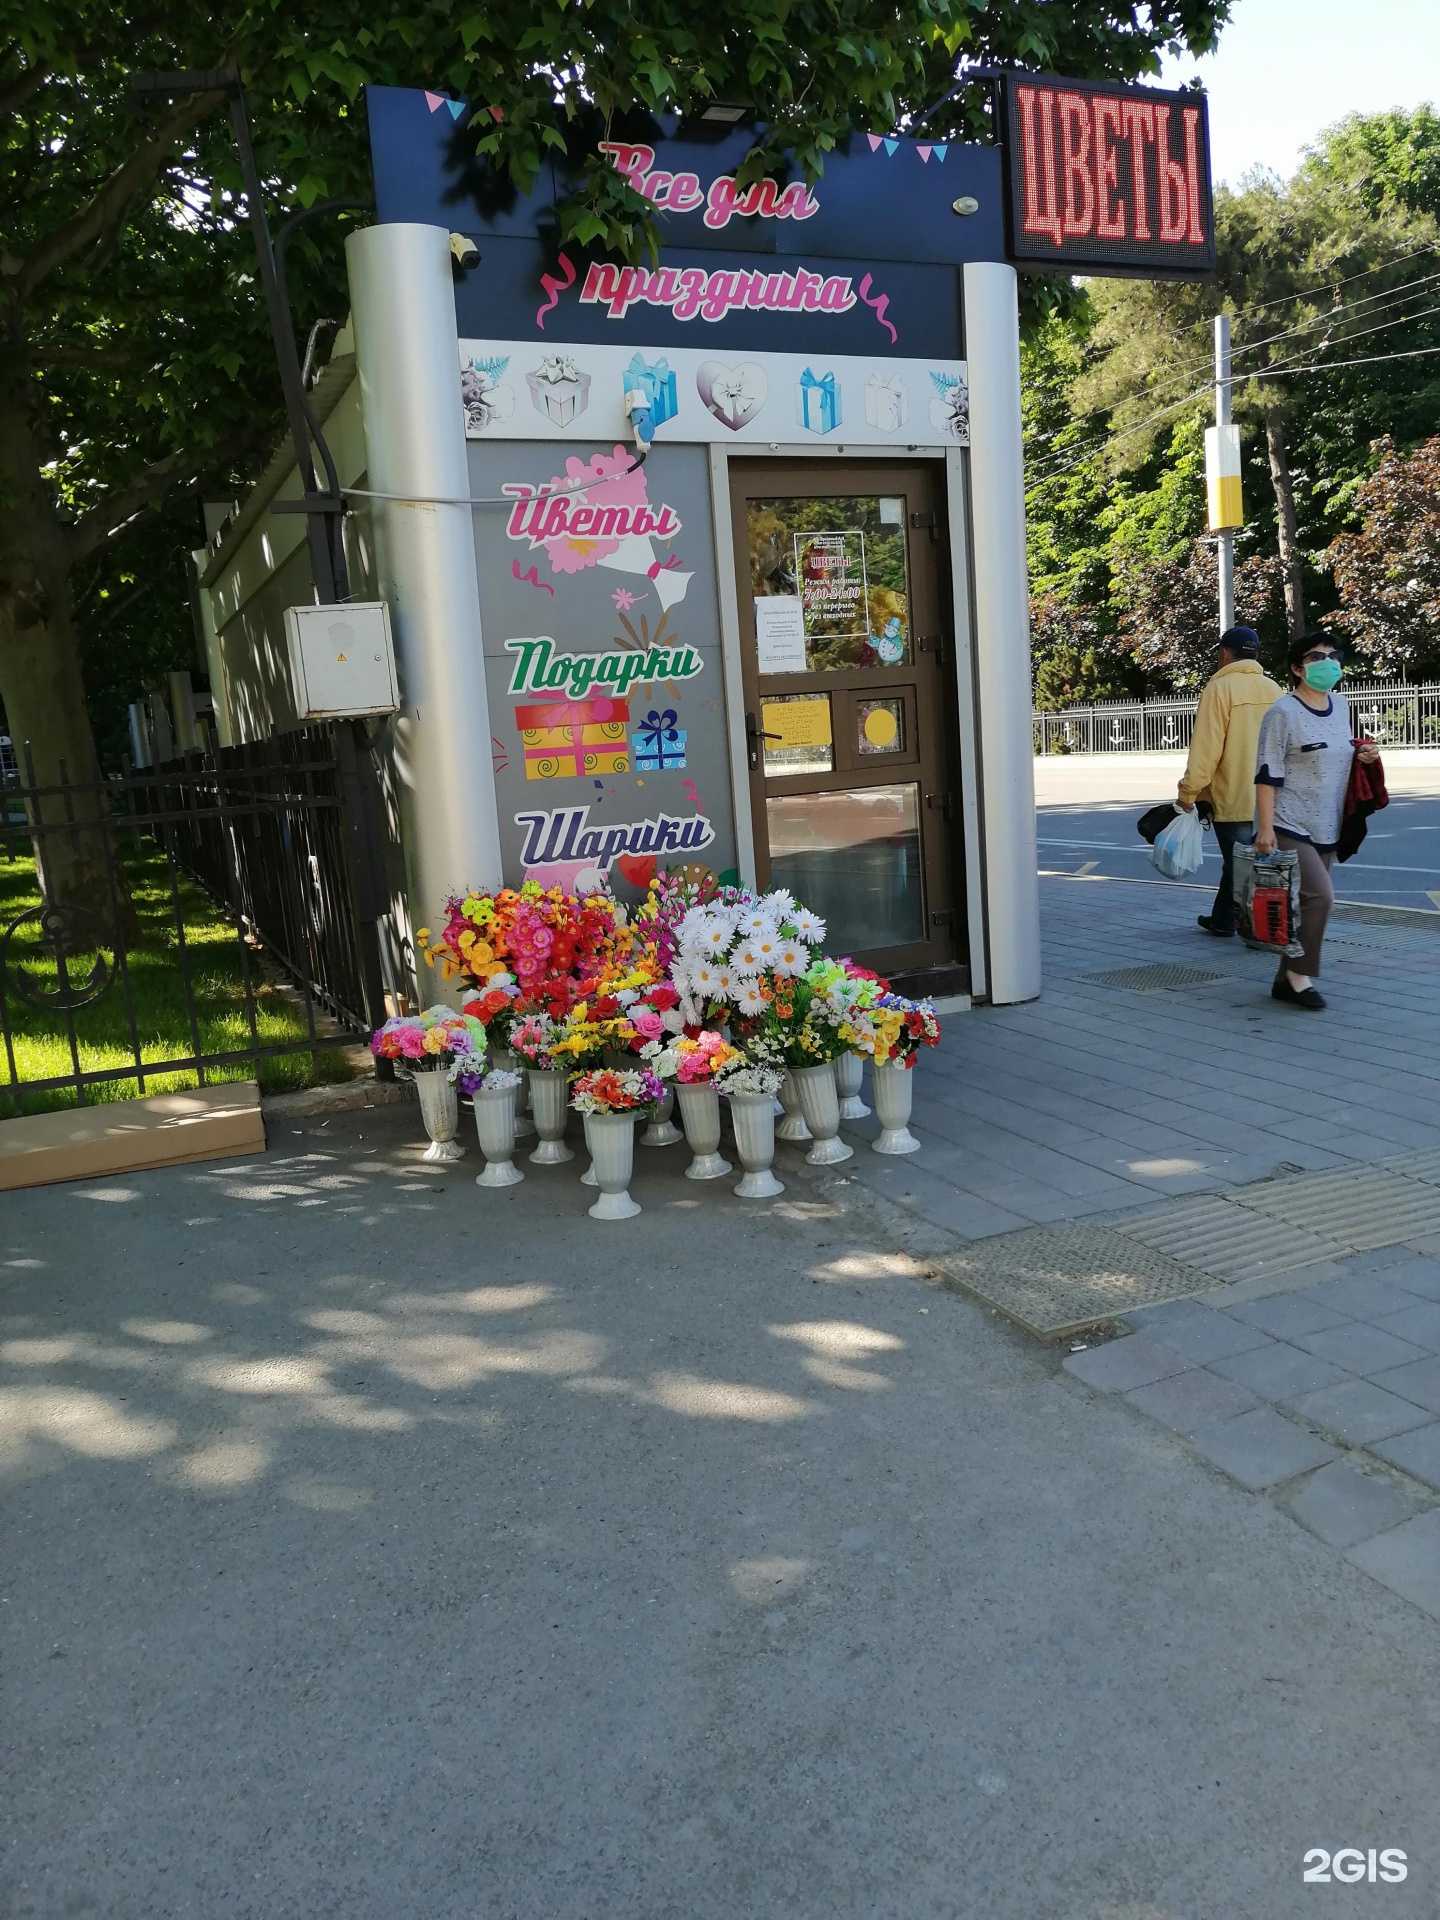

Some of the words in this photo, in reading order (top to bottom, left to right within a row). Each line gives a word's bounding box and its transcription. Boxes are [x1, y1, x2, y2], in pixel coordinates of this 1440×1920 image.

[1018, 87, 1204, 247] ЦВЕТЫ
[704, 176, 820, 229] для
[580, 260, 857, 322] праздника
[501, 482, 682, 550] Цветы
[504, 635, 704, 699] Подарки
[514, 805, 715, 871] Шарики
